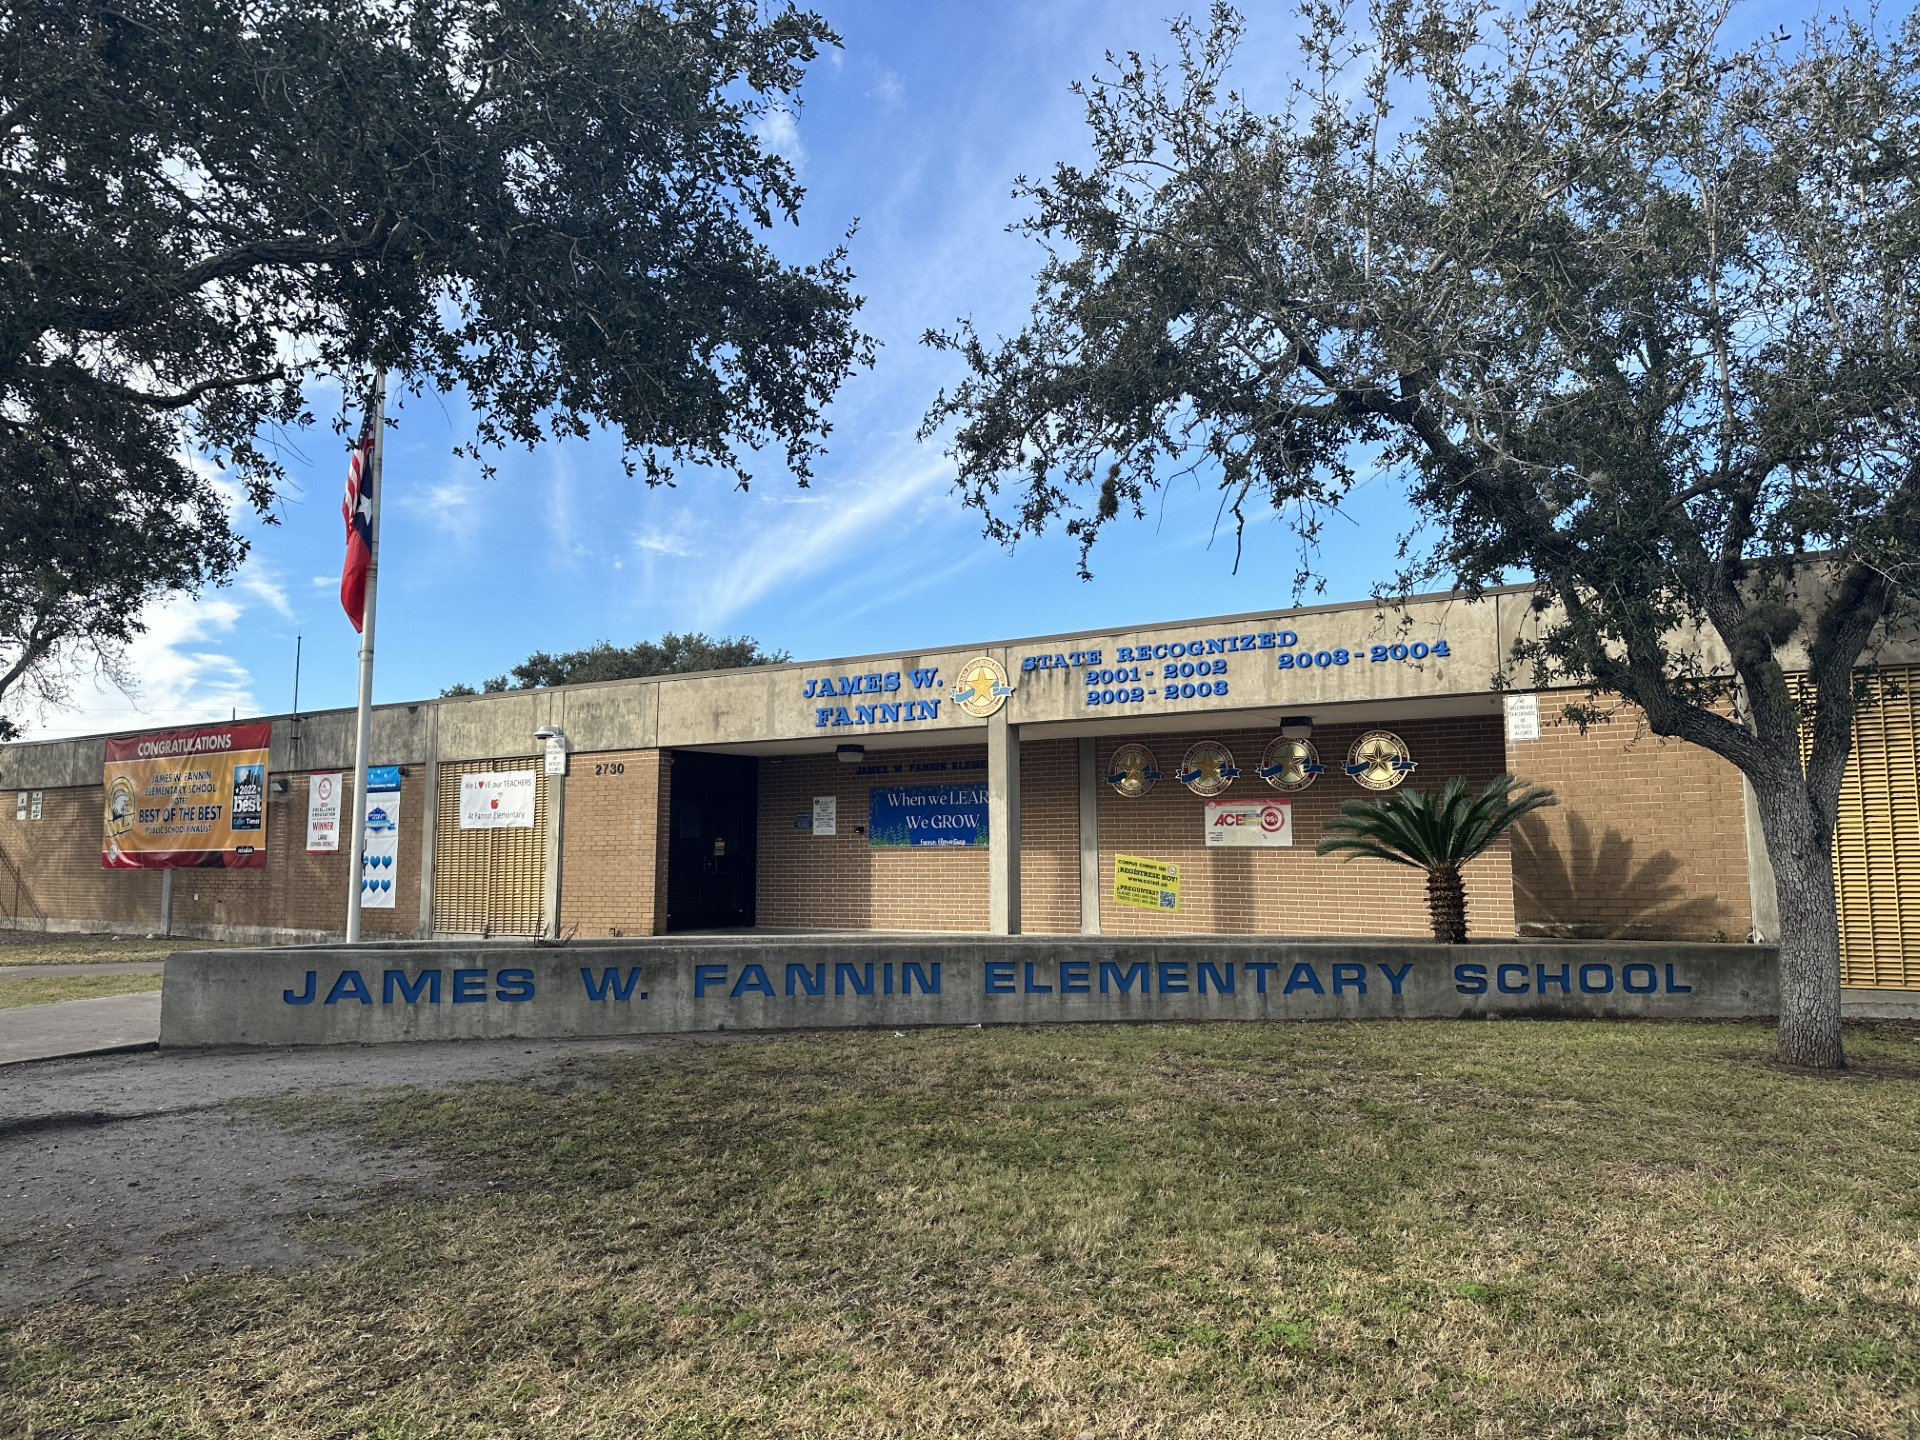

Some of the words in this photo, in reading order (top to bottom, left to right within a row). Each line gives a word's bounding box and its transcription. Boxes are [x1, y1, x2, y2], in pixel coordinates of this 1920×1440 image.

[1023, 650, 1102, 671] STATE
[1116, 630, 1298, 663] RECOGNIZED
[802, 671, 901, 698] JAMES
[907, 667, 943, 689] W.
[815, 698, 941, 727] FANNIN
[138, 734, 231, 756] CONGRATULATIONS
[595, 763, 625, 775] 2730
[856, 765, 888, 775] JAMES
[910, 762, 947, 772] FANNIN
[151, 773, 172, 783] JAMES
[184, 770, 212, 781] FANNIN
[145, 785, 187, 796] ELEMENTARY
[188, 783, 216, 793] SCHOOL
[239, 785, 256, 794] 2022
[503, 779, 532, 788] TEACHERS
[233, 795, 261, 812] best
[887, 792, 926, 807] When
[928, 794, 947, 805] we
[950, 789, 990, 805] LEAR
[139, 808, 161, 823] BEST
[163, 807, 176, 822] OF
[179, 806, 195, 821] THE
[198, 805, 223, 820] BEST
[468, 812, 474, 820] At
[474, 811, 492, 820] Fannin
[493, 810, 525, 820] Elementary
[1213, 813, 1243, 826] ACE
[312, 821, 334, 831] WINNER
[906, 815, 929, 829] We
[931, 814, 980, 829] GROW
[185, 824, 212, 833] FINALIST
[282, 968, 535, 1005] JAMES
[580, 966, 649, 1002] W.
[693, 962, 941, 998] FANNIN
[983, 961, 1414, 995] ELEMENTARY
[1453, 963, 1693, 994] SCHOOL
